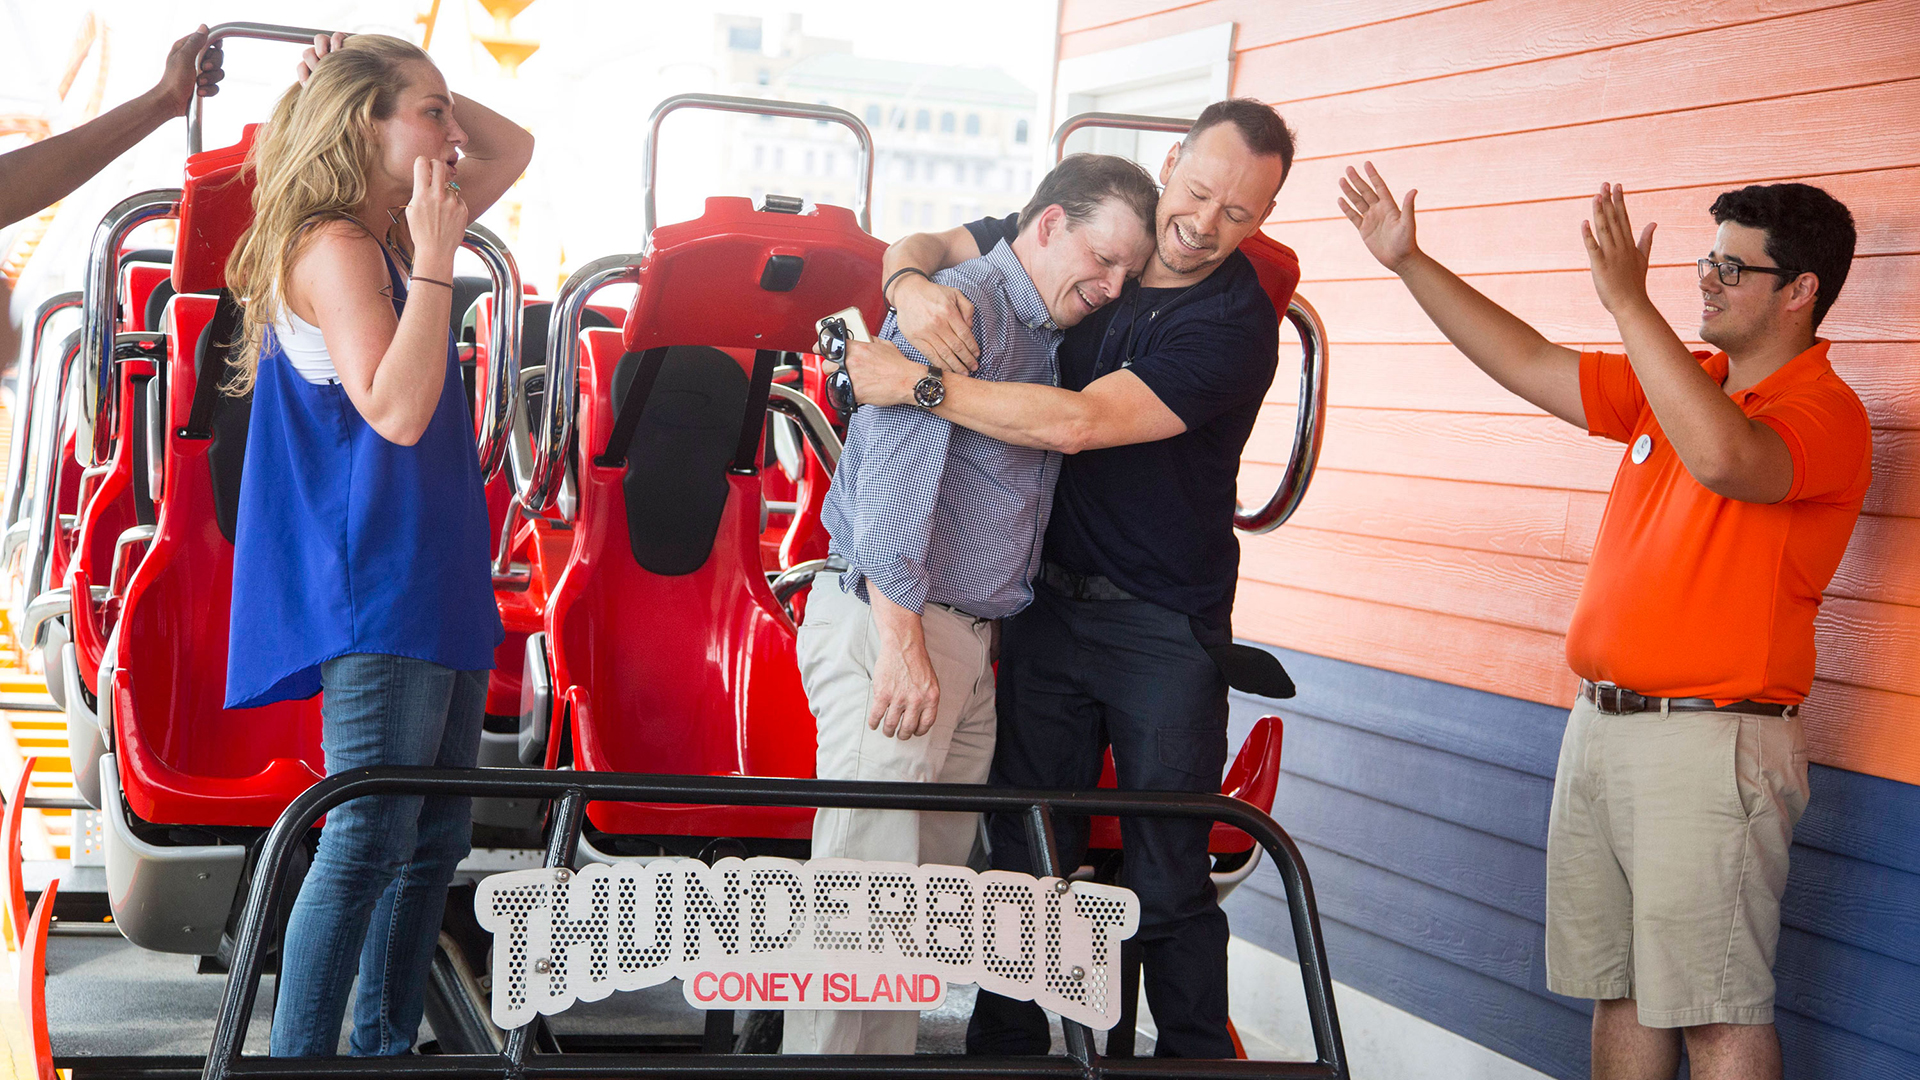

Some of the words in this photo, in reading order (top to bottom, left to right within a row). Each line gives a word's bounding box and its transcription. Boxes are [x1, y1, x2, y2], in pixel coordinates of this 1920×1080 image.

[492, 868, 1127, 1016] THUNDERBOLT
[692, 971, 813, 1002] CONEY
[822, 972, 941, 1003] ISLAND
